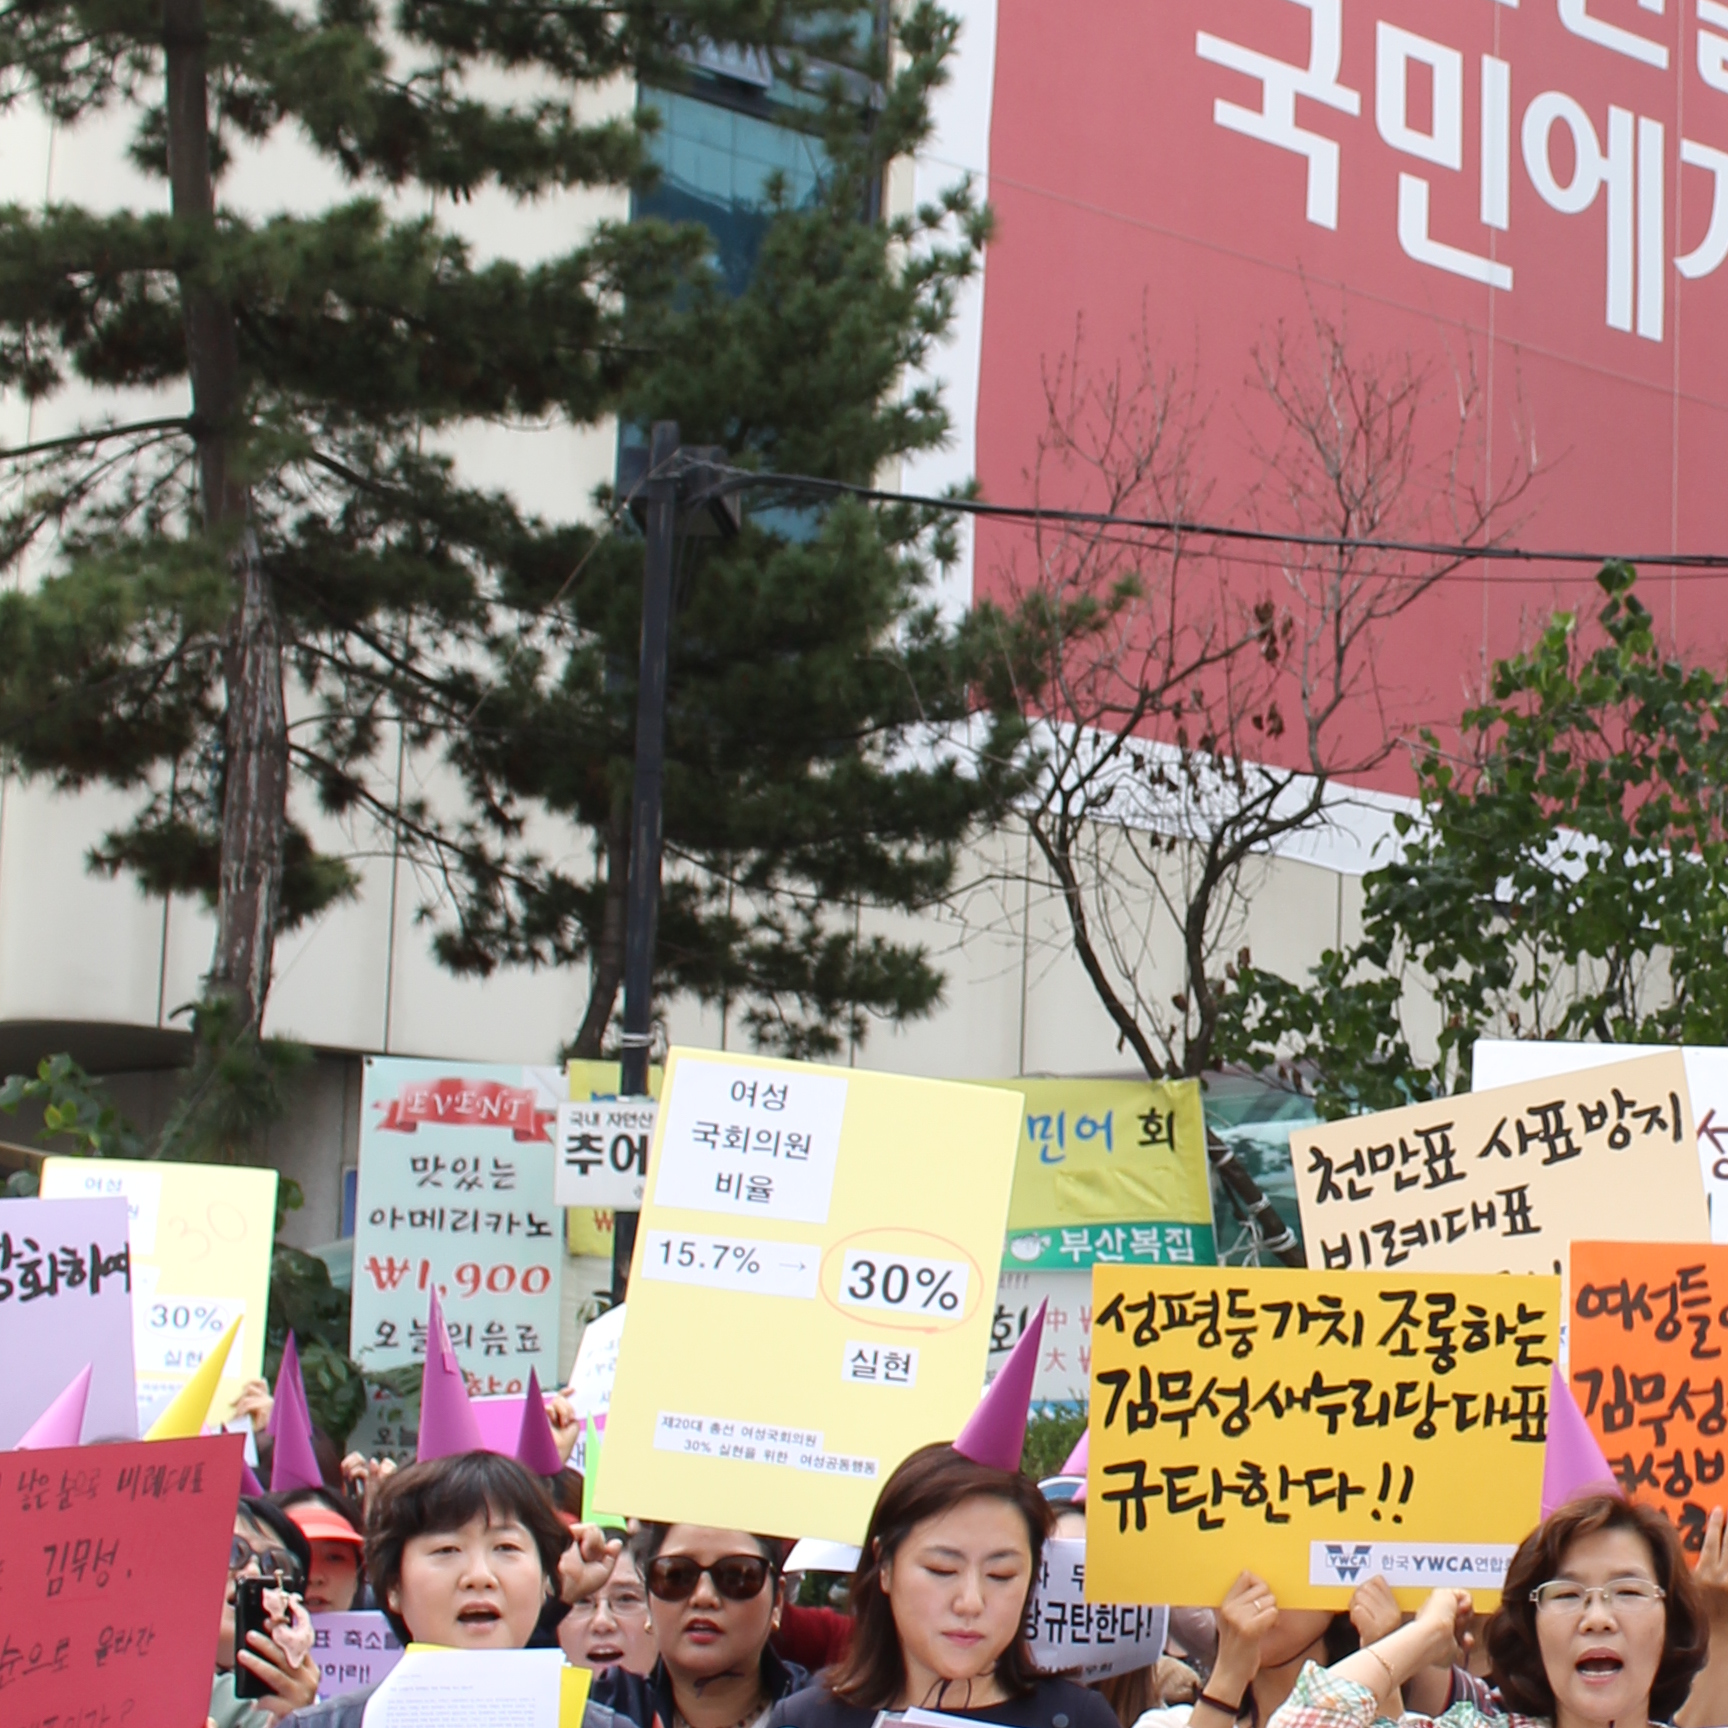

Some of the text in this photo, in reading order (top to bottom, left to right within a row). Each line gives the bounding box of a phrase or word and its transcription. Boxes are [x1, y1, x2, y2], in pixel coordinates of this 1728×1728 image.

[405, 1087, 527, 1123] EVENT
[730, 1079, 790, 1112] 여성
[691, 1120, 814, 1162] 국회의원
[1026, 1106, 1177, 1166] 민어 회
[1307, 1087, 1684, 1205] 천만표 사표방지
[410, 1155, 518, 1191] 맛있는
[714, 1171, 775, 1205] 비율
[368, 1207, 554, 1239] 아메리카노
[1320, 1183, 1543, 1270] 비례대표
[658, 1238, 762, 1275] 15.7%
[1059, 1226, 1197, 1263] 부산복집
[846, 1258, 961, 1313] 30%
[150, 1303, 224, 1332] 30%
[1095, 1288, 1365, 1360] 성평등가치
[1377, 1288, 1555, 1375] 조롱하는
[849, 1349, 913, 1384] 실현
[708, 1420, 818, 1449] 총선 여성국회의원
[683, 1439, 878, 1477] 30% 실현을 위한 여성공동행동
[1100, 1459, 1416, 1535] 규탄한다!!
